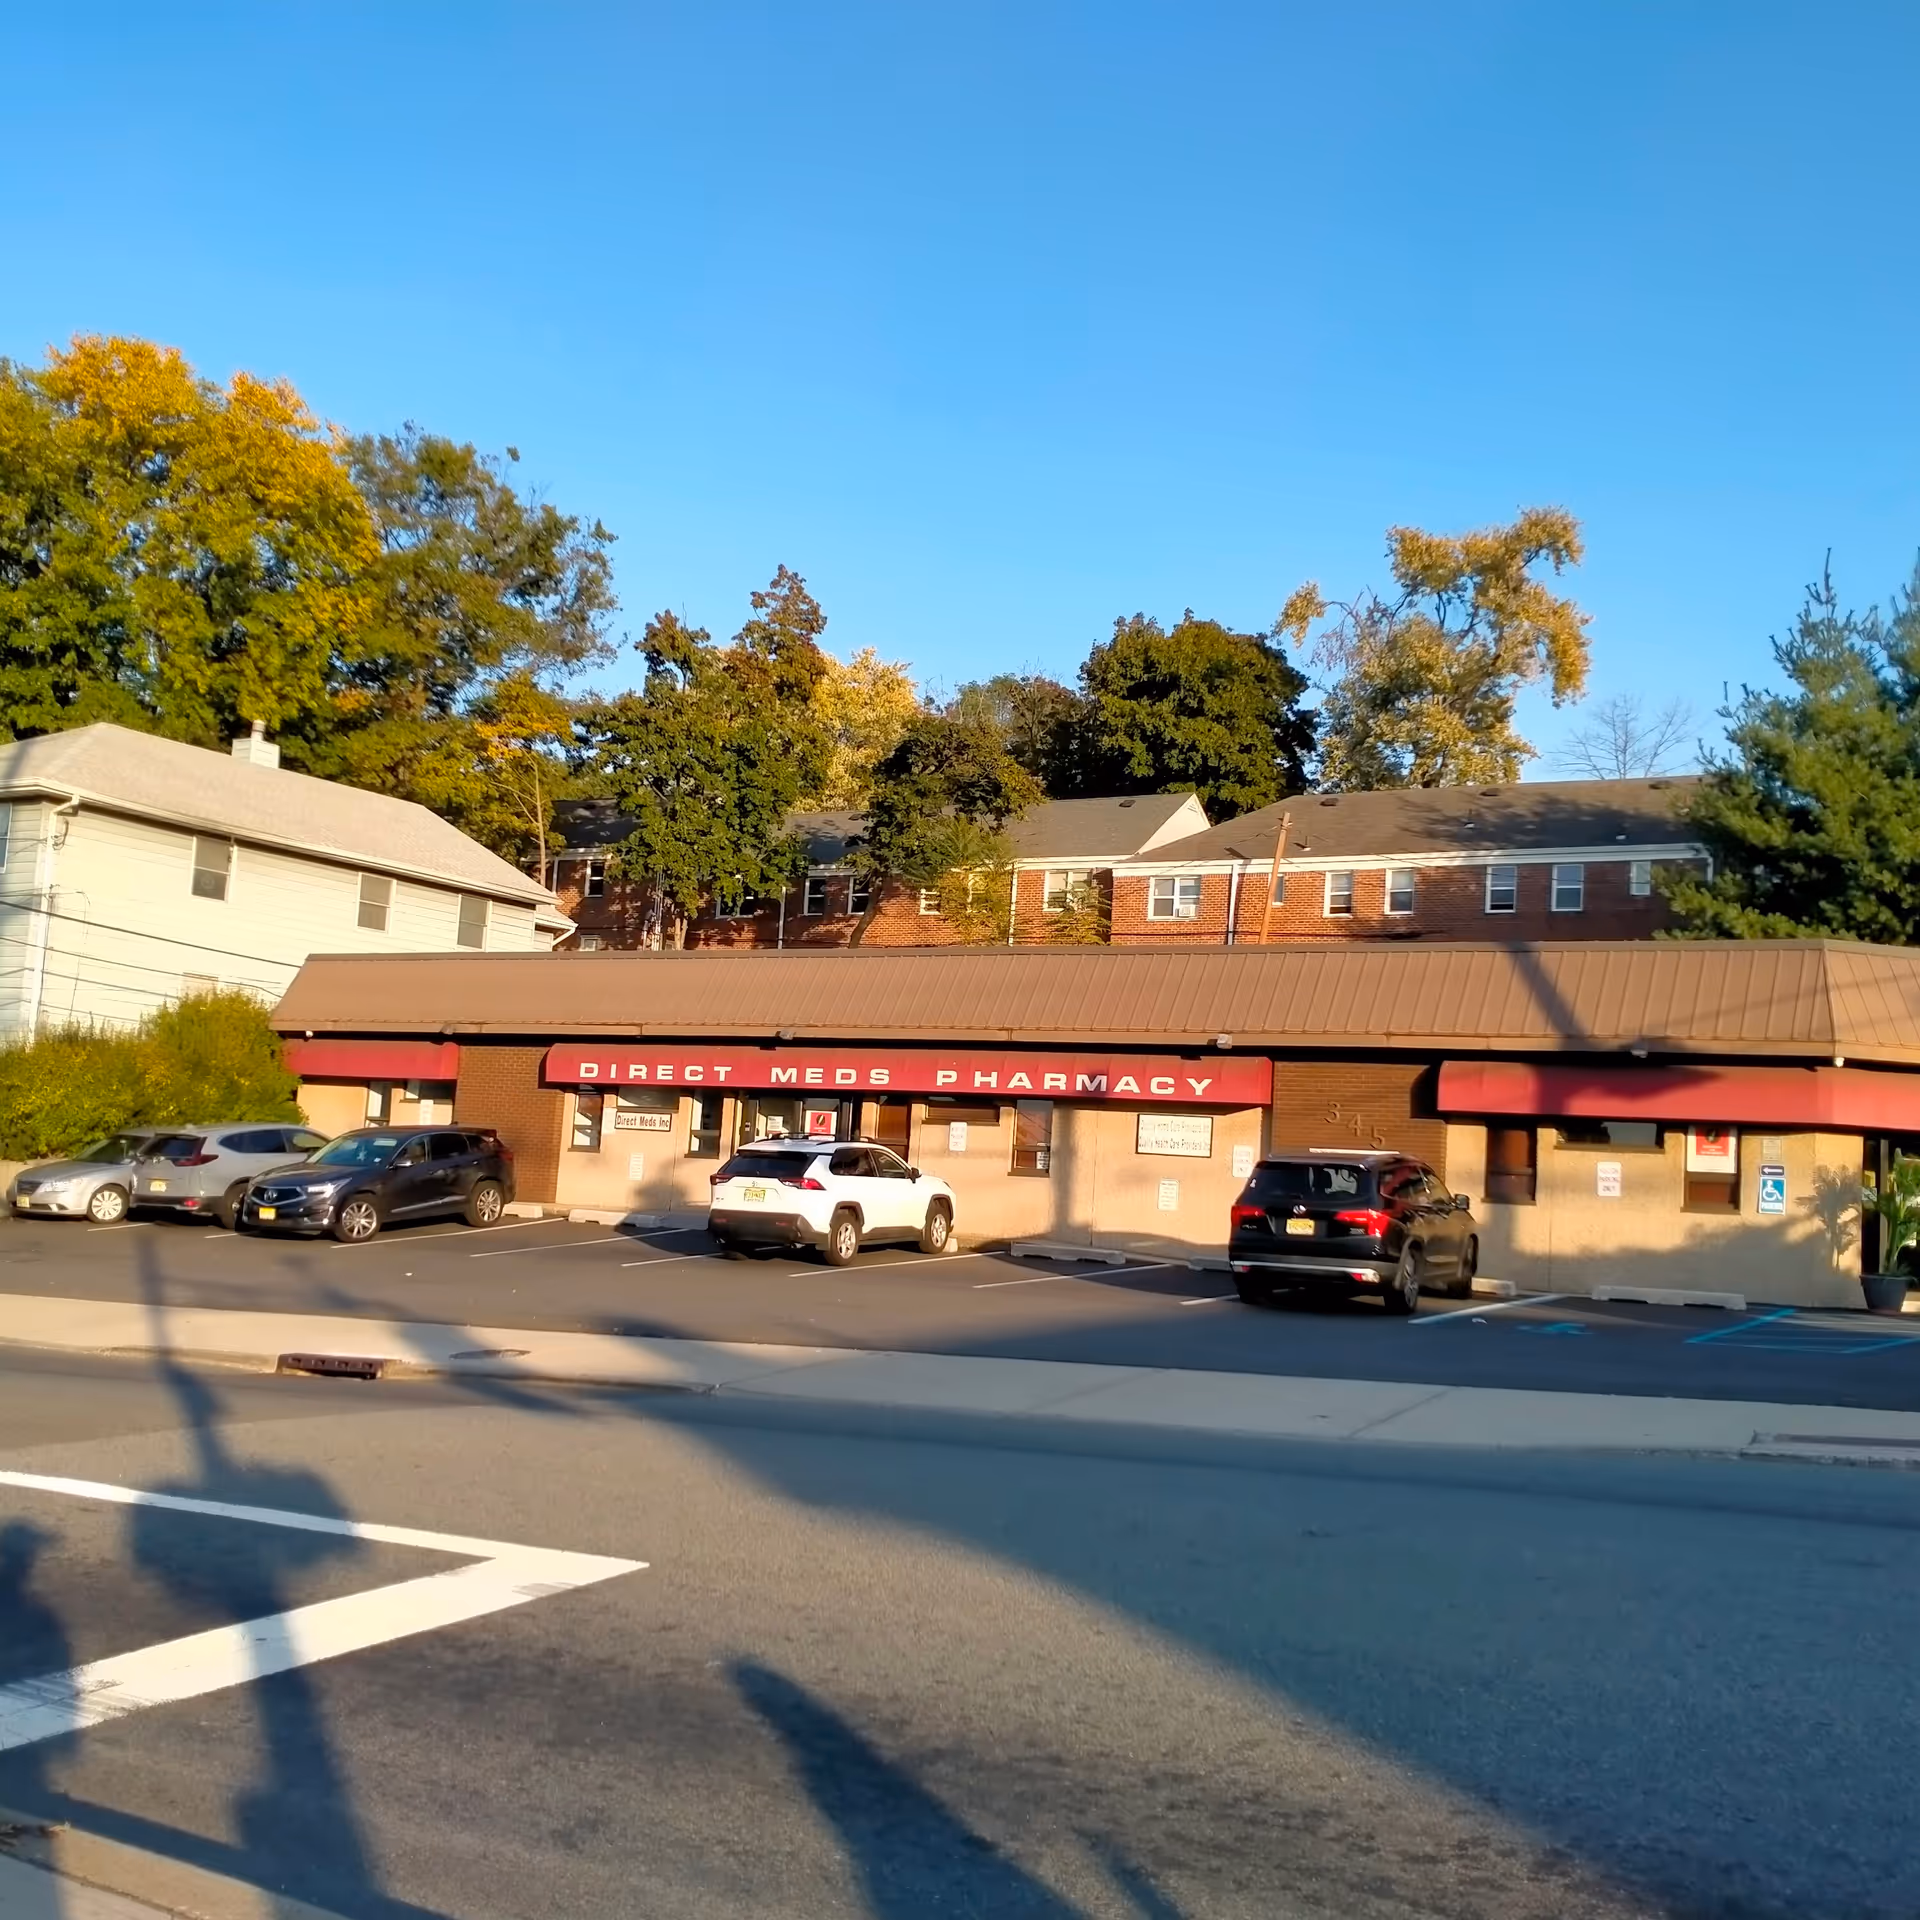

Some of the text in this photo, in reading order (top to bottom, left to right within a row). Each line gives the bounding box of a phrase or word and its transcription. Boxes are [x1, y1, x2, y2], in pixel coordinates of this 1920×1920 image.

[579, 1062, 1213, 1096] DIRECT MEDS PHARMACY
[616, 1114, 670, 1129] Direct Meds Inc
[1323, 1101, 1386, 1150] 345
